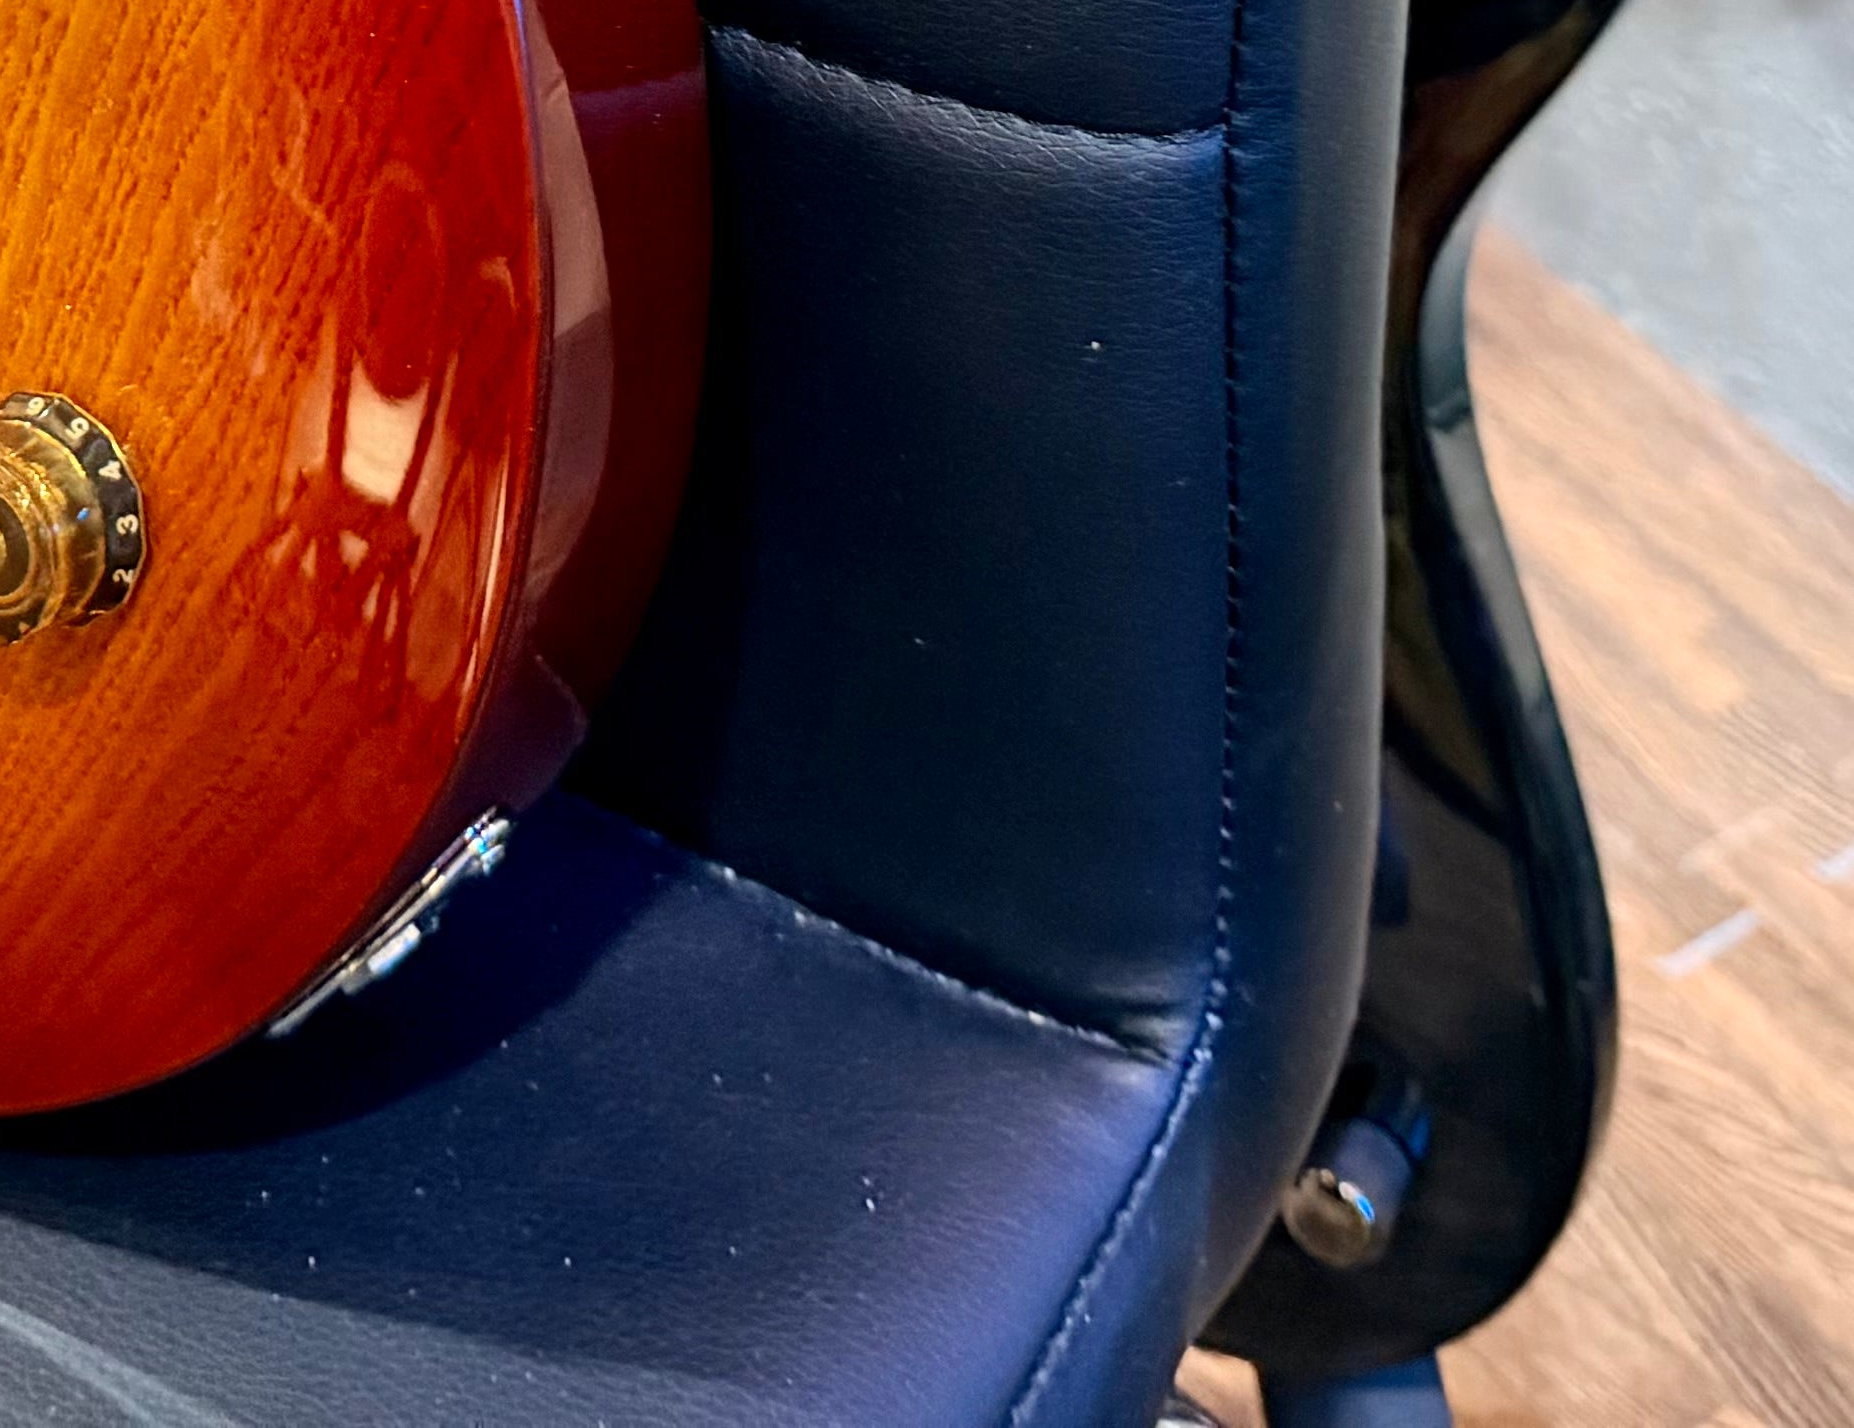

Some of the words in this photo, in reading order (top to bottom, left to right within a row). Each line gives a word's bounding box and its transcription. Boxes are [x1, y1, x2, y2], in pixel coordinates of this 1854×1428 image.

[65, 416, 90, 440] 5
[98, 459, 122, 480] 4
[116, 513, 138, 535] 3
[113, 568, 135, 584] 2
